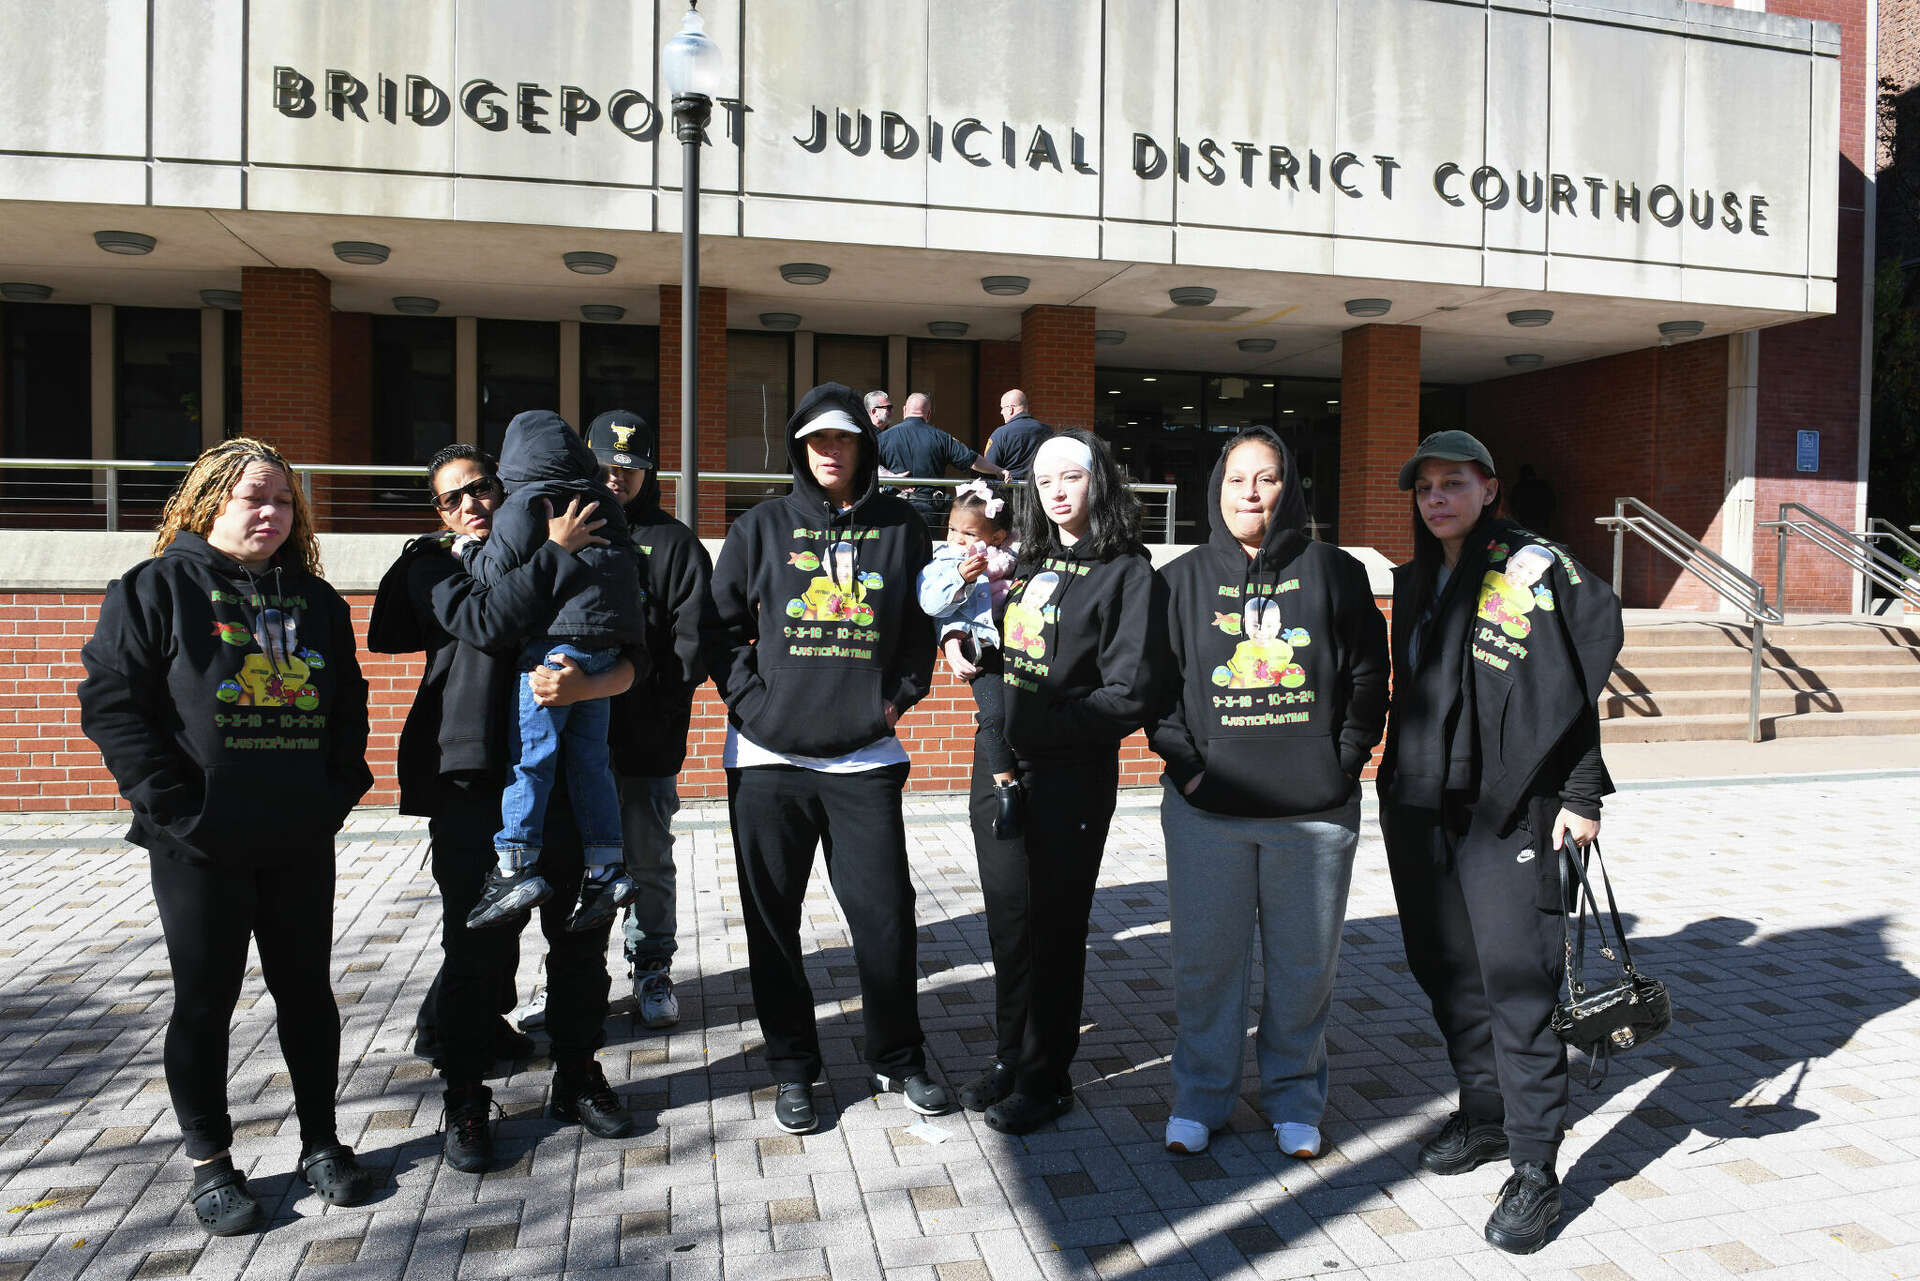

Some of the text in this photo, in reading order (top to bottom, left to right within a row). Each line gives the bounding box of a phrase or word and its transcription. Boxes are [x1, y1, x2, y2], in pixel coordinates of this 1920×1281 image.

[793, 104, 1093, 173] JUDICIAL
[1132, 132, 1397, 196] DISTRICT
[1432, 161, 1769, 236] COURTHOUSE
[1218, 584, 1240, 598] RES
[1268, 690, 1316, 706] 10-2-24
